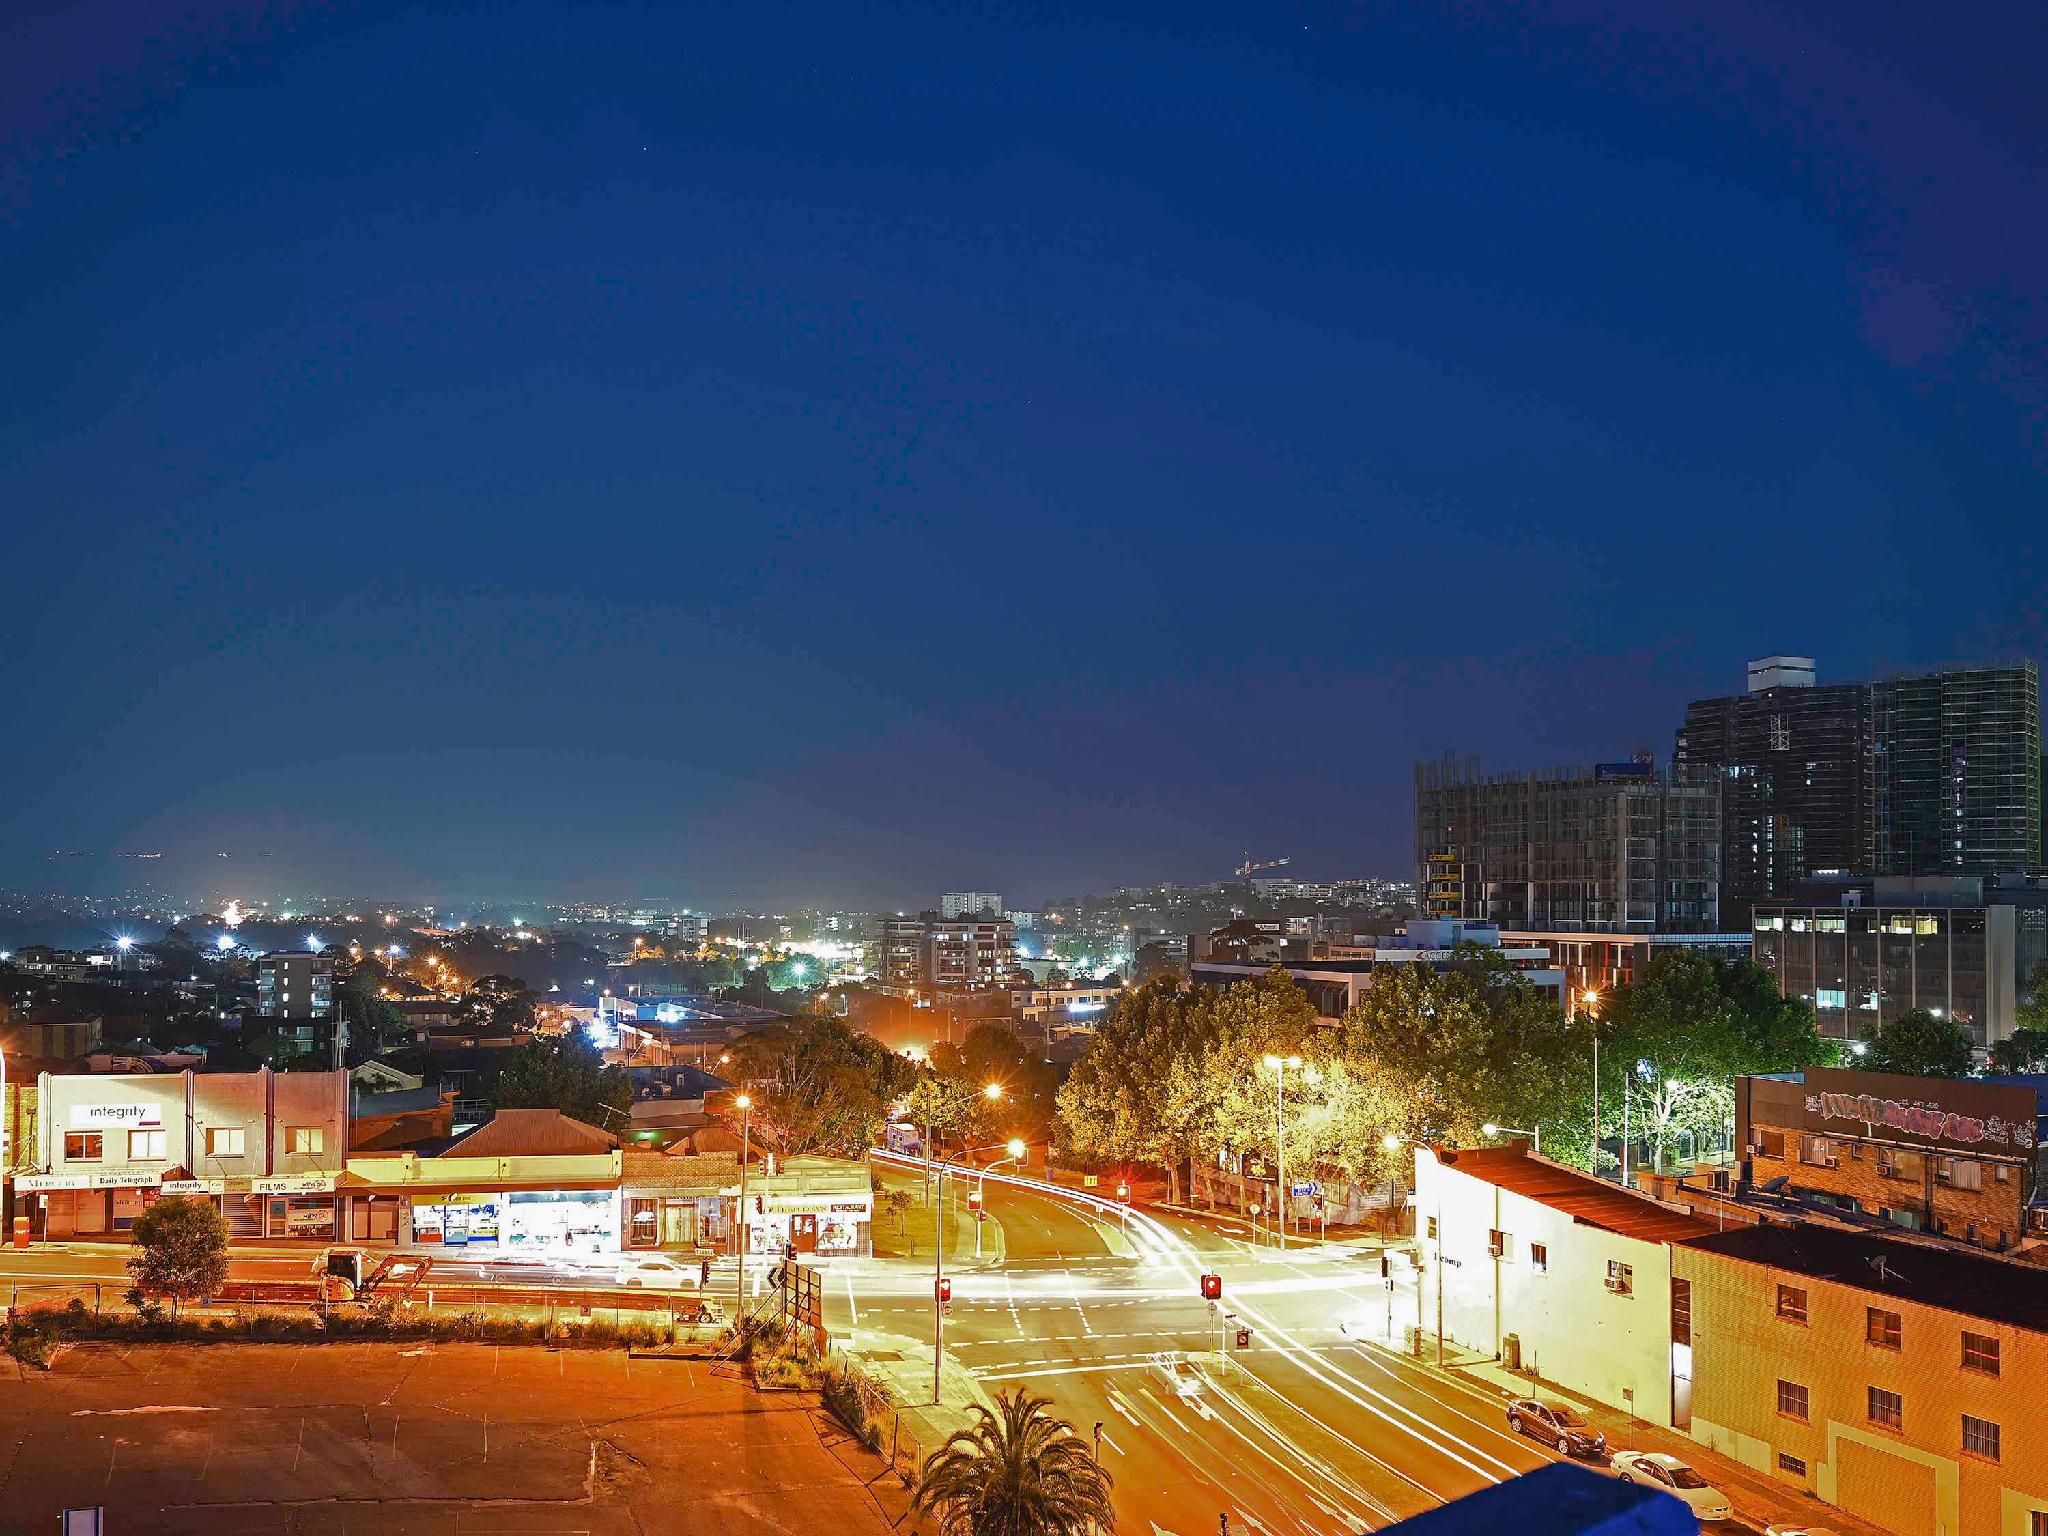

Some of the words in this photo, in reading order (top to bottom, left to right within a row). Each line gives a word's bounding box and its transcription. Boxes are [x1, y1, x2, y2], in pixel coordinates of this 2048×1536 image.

[90, 1106, 146, 1119] integrity
[120, 1174, 153, 1184] Telegraph
[259, 1183, 287, 1191] FILMS
